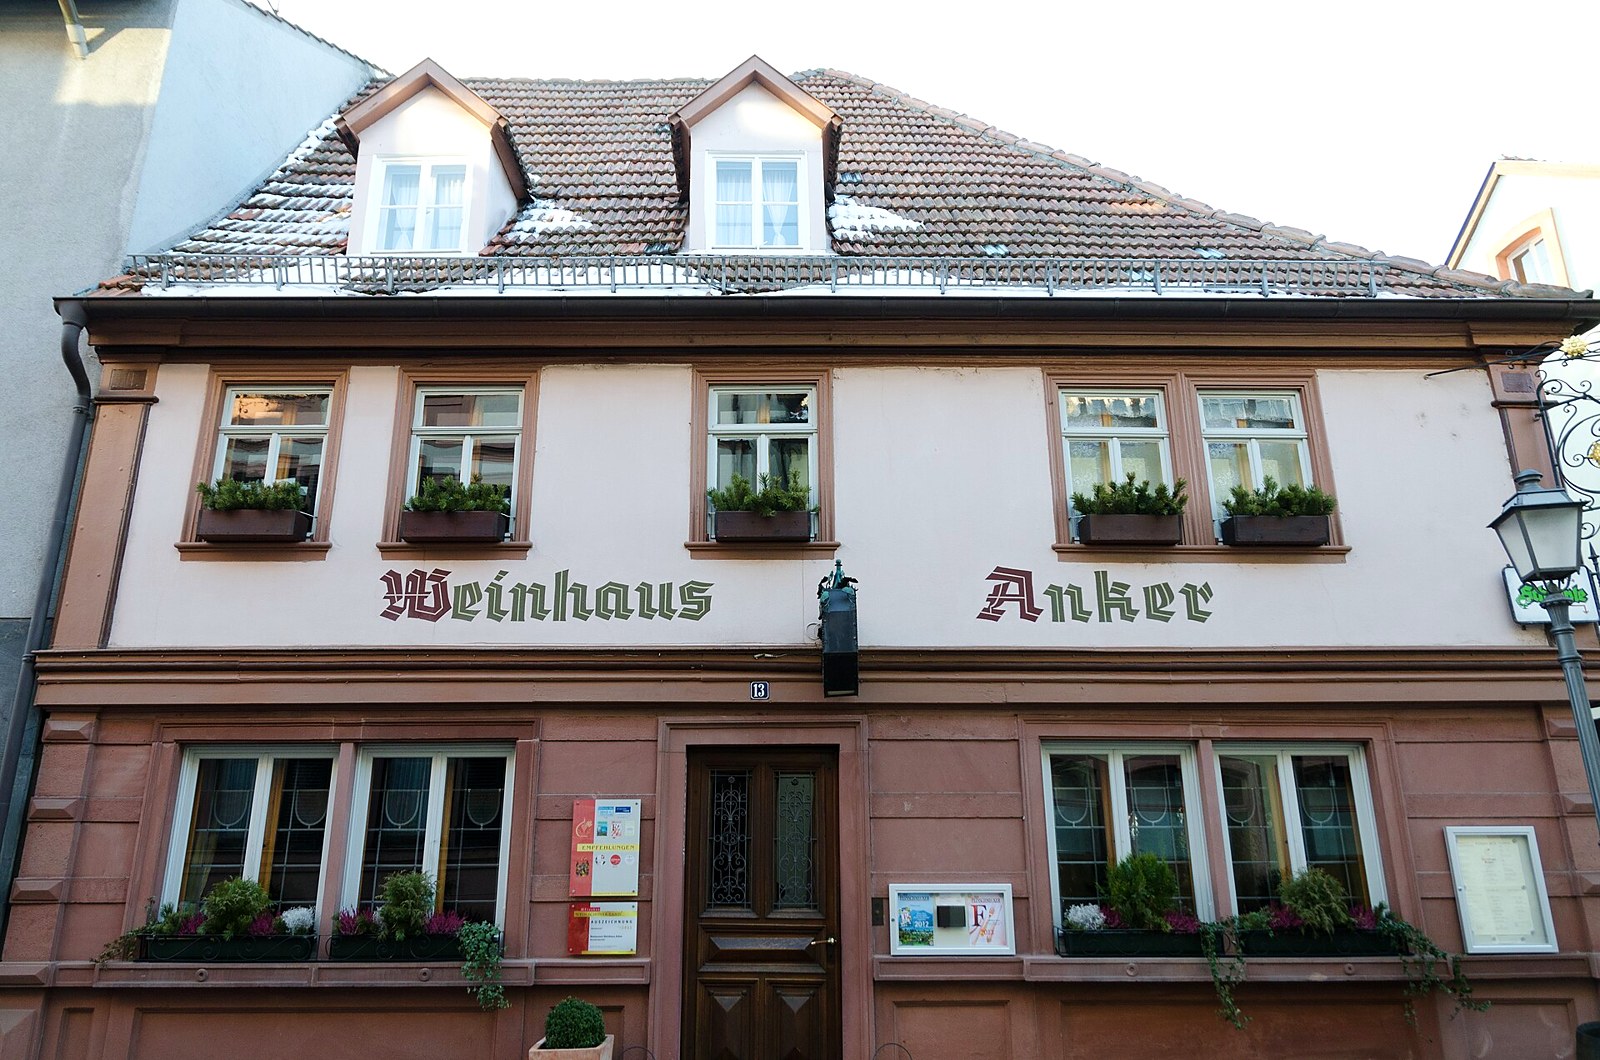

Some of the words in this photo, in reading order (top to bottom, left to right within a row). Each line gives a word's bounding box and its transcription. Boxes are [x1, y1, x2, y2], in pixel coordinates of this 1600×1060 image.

[379, 568, 715, 623] Weinhaus
[976, 565, 1214, 624] Anker
[753, 683, 765, 698] 13
[972, 904, 987, 926] F
